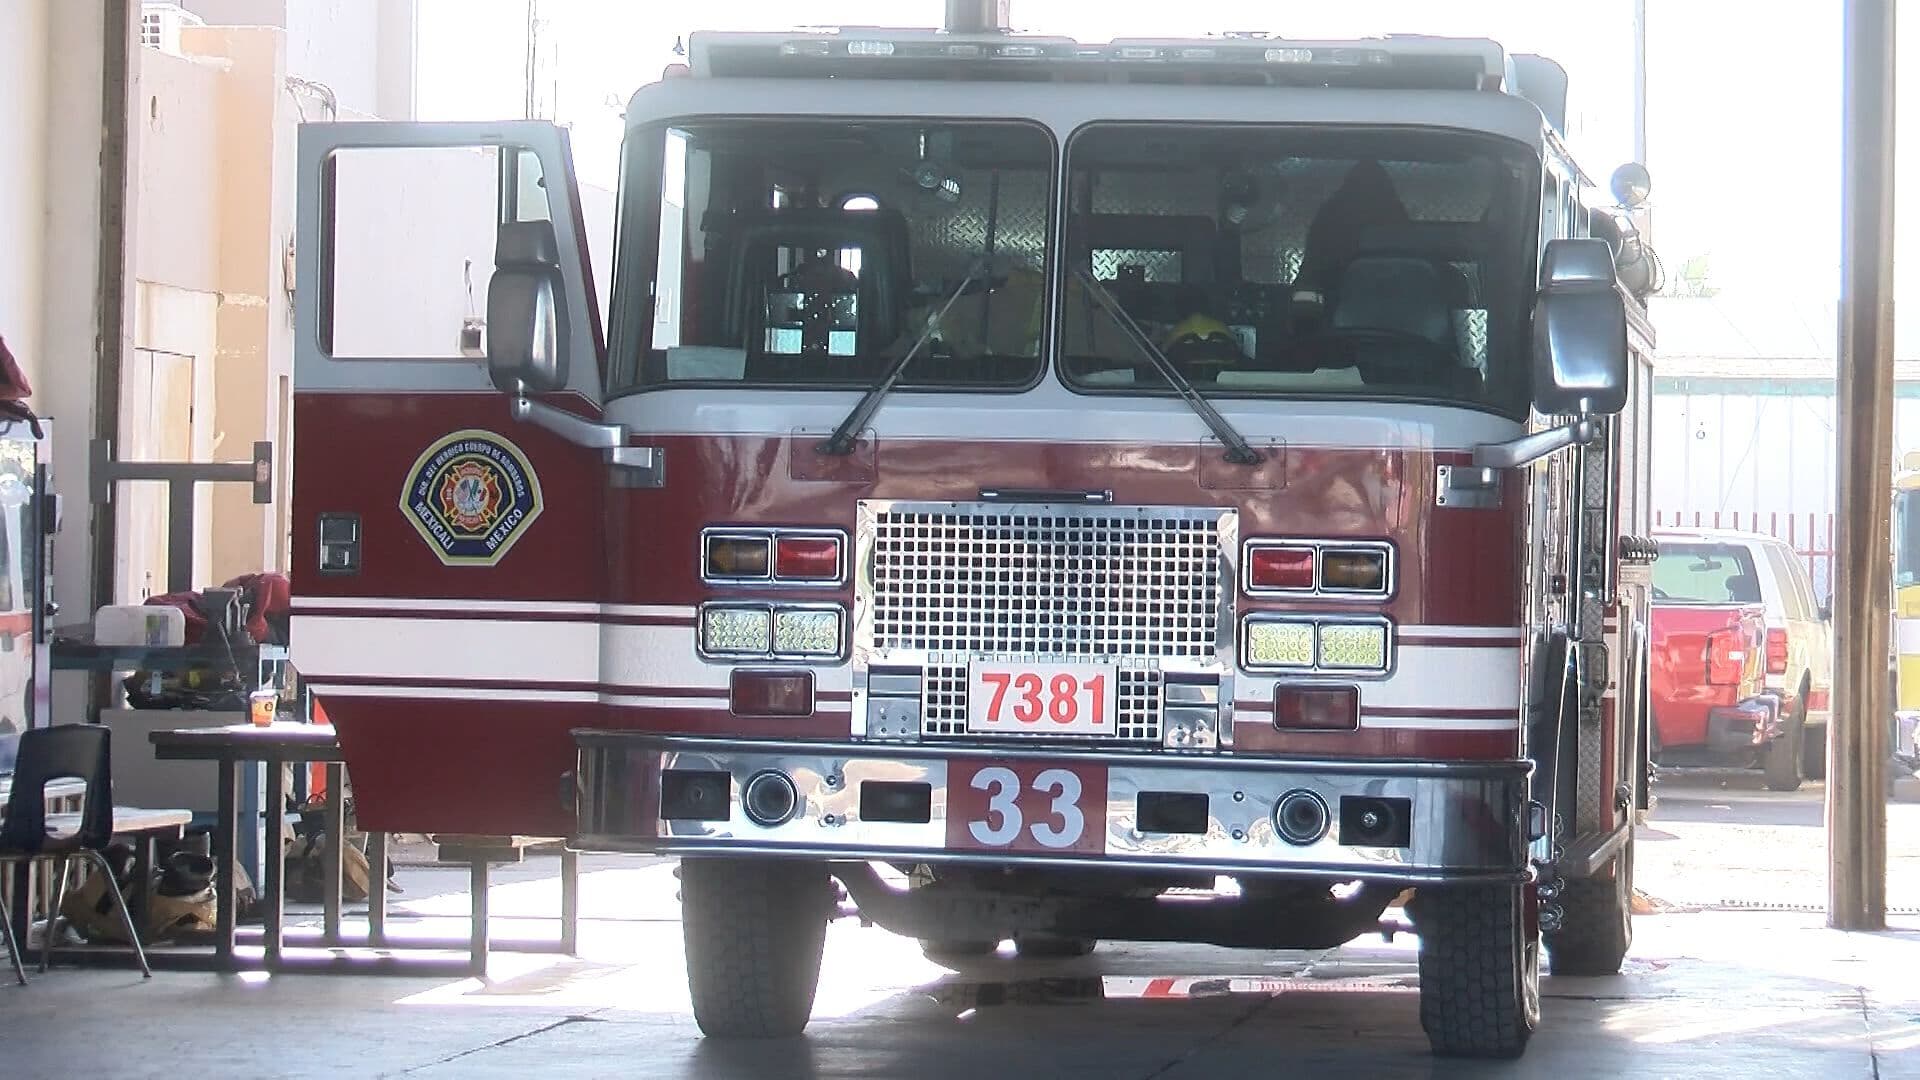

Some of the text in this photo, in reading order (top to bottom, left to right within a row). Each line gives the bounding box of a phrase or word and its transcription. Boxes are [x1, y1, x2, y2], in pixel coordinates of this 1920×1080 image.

[414, 501, 455, 550] MEXICALI
[485, 508, 523, 550] MEXICO
[981, 672, 1105, 724] 7381
[967, 766, 1085, 848] 33
